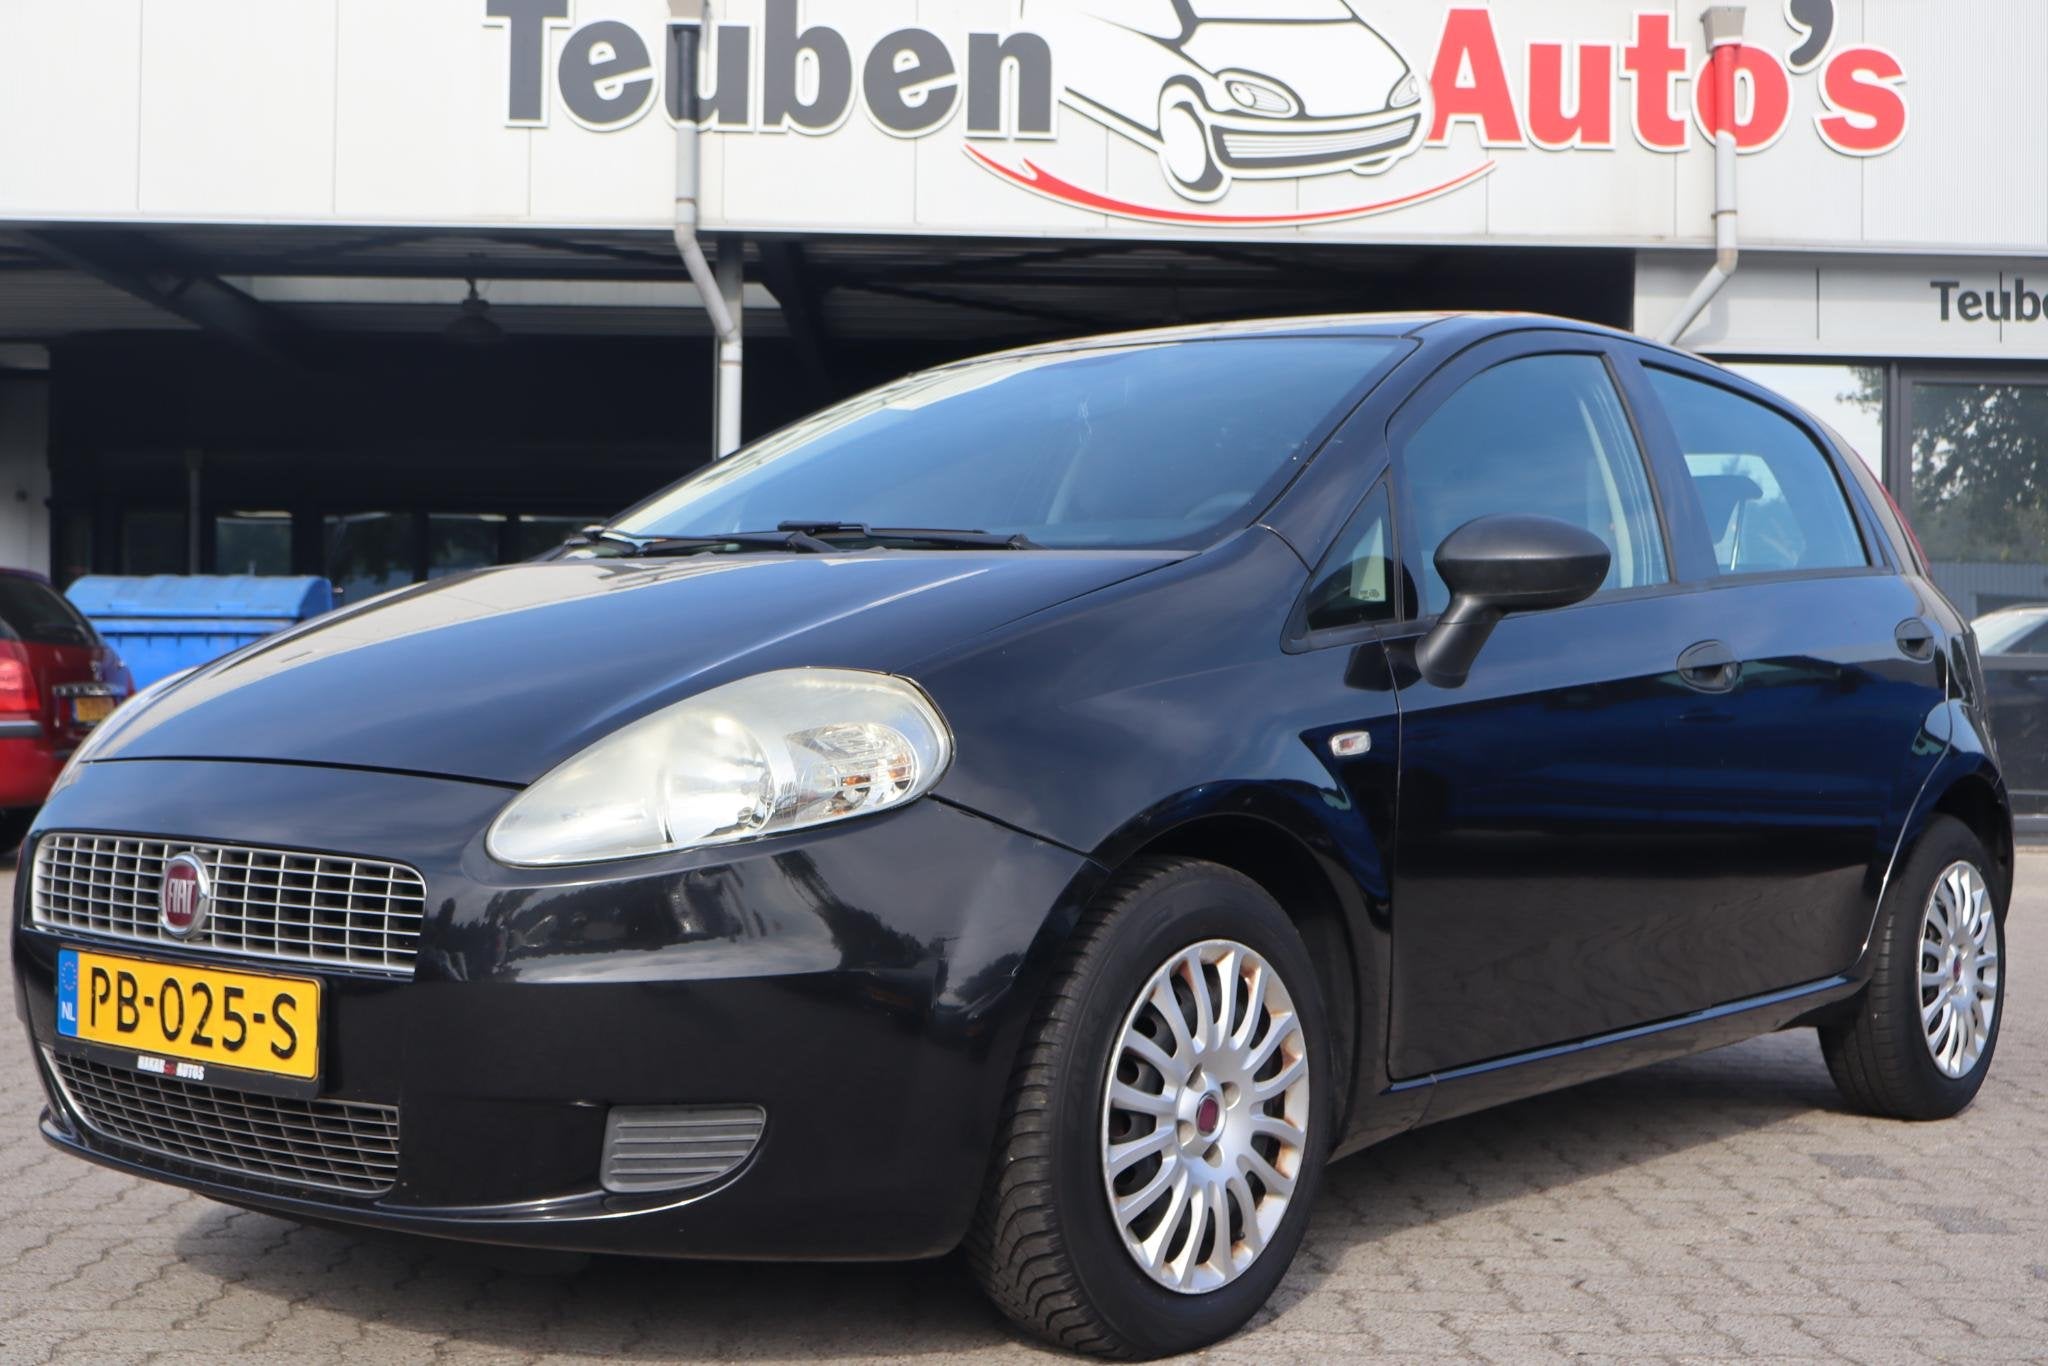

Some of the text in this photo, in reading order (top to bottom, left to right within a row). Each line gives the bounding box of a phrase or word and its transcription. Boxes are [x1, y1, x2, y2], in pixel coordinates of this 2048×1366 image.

[485, 0, 1906, 151] Teuben Auto's
[1930, 278, 2048, 322] Teub
[167, 878, 195, 914] FIAT
[61, 1001, 76, 1021] NL
[91, 967, 297, 1060] PB-025-S
